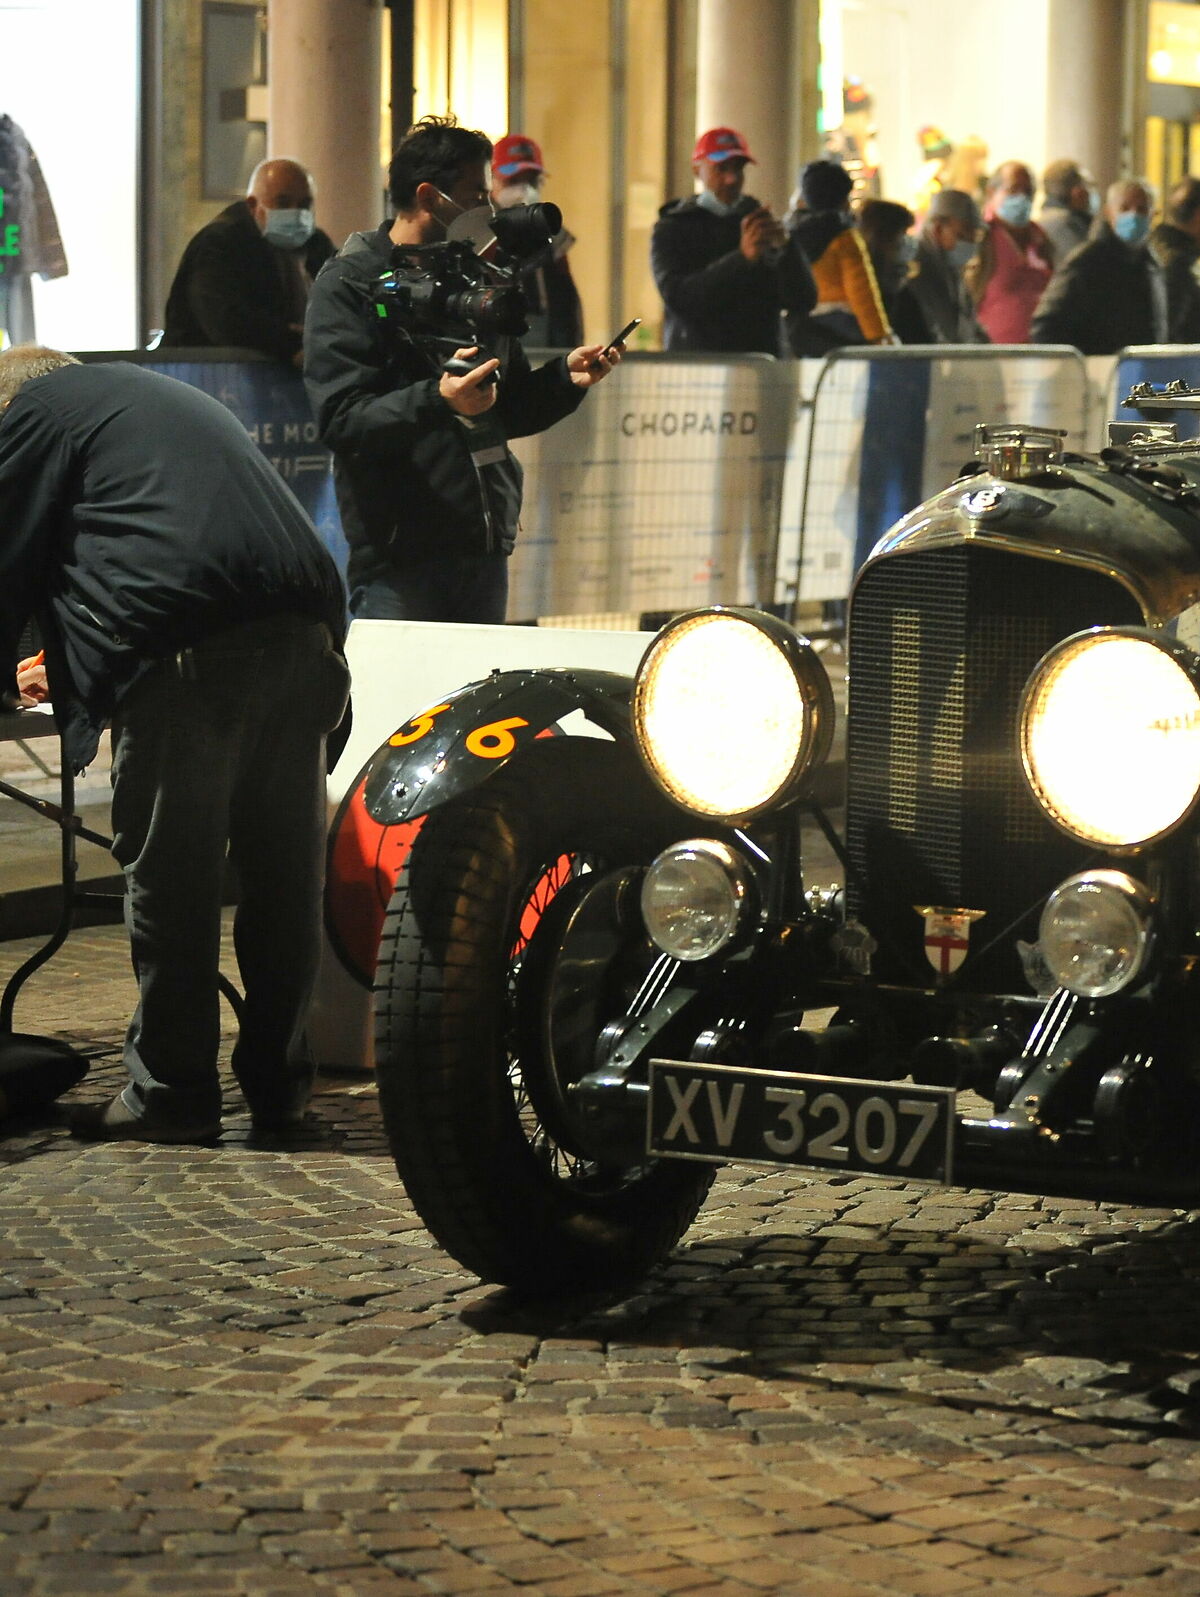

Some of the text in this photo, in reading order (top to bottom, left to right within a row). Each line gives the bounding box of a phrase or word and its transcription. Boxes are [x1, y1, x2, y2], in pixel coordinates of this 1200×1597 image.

[622, 411, 758, 437] CHOPARD
[388, 703, 530, 759] 36
[662, 1075, 940, 1168] XV 3207
